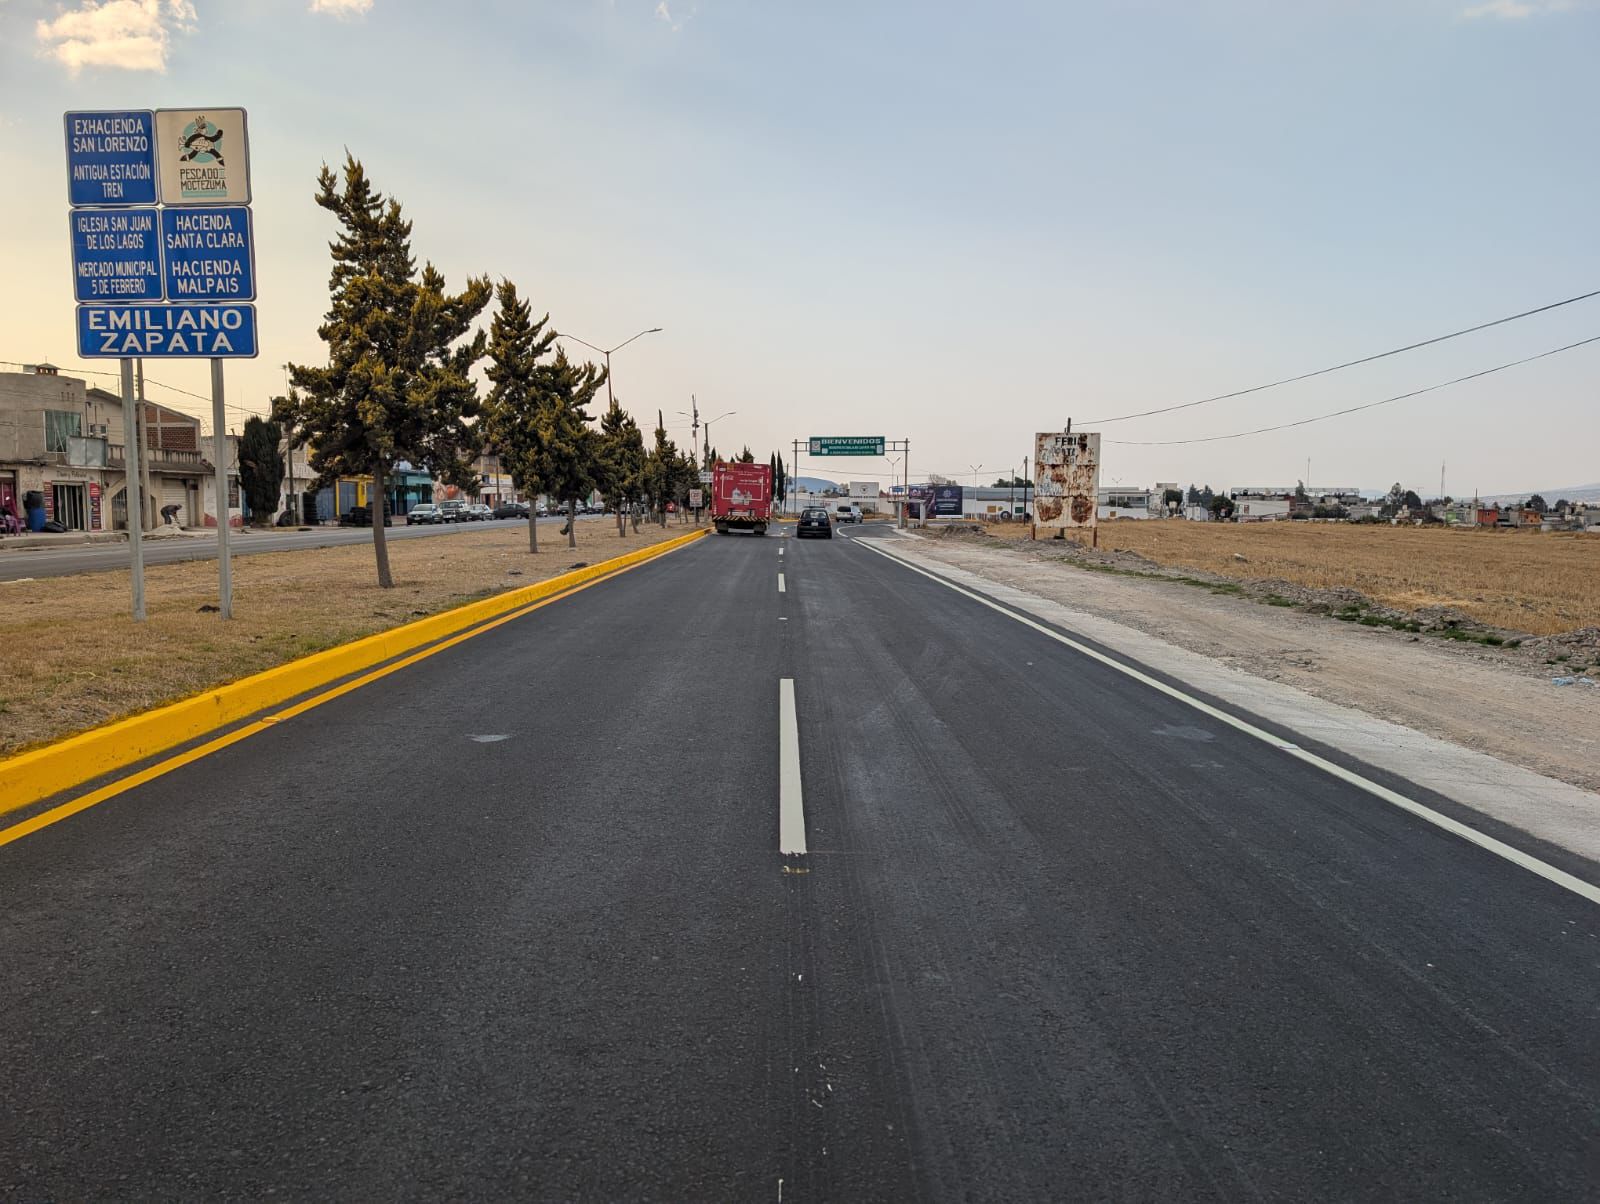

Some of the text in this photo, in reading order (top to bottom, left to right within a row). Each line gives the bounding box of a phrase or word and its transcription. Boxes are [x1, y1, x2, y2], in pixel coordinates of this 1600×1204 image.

[75, 119, 144, 135] EXHACIENDA
[73, 136, 148, 152] SAN LORENZO
[74, 161, 150, 180] ANTIGUA ESTACIÓN
[180, 168, 219, 180] PESCADO
[102, 182, 123, 197] TREN
[180, 180, 227, 192] MOCTEZUMA
[77, 216, 151, 232] IGLESIA SAN JUAN
[176, 215, 232, 231] HACIENDA
[86, 234, 144, 250] DE LOS LAGOS
[167, 232, 244, 249] SANTA CLARA
[78, 261, 157, 277] MERCADO MUNICIPAL
[172, 260, 242, 276] HACIENDA
[91, 279, 146, 294] 5 DE FEBRERO
[177, 278, 239, 294] MALPAIS
[88, 309, 243, 330] EMILIANO
[100, 332, 234, 353] ZAPATA
